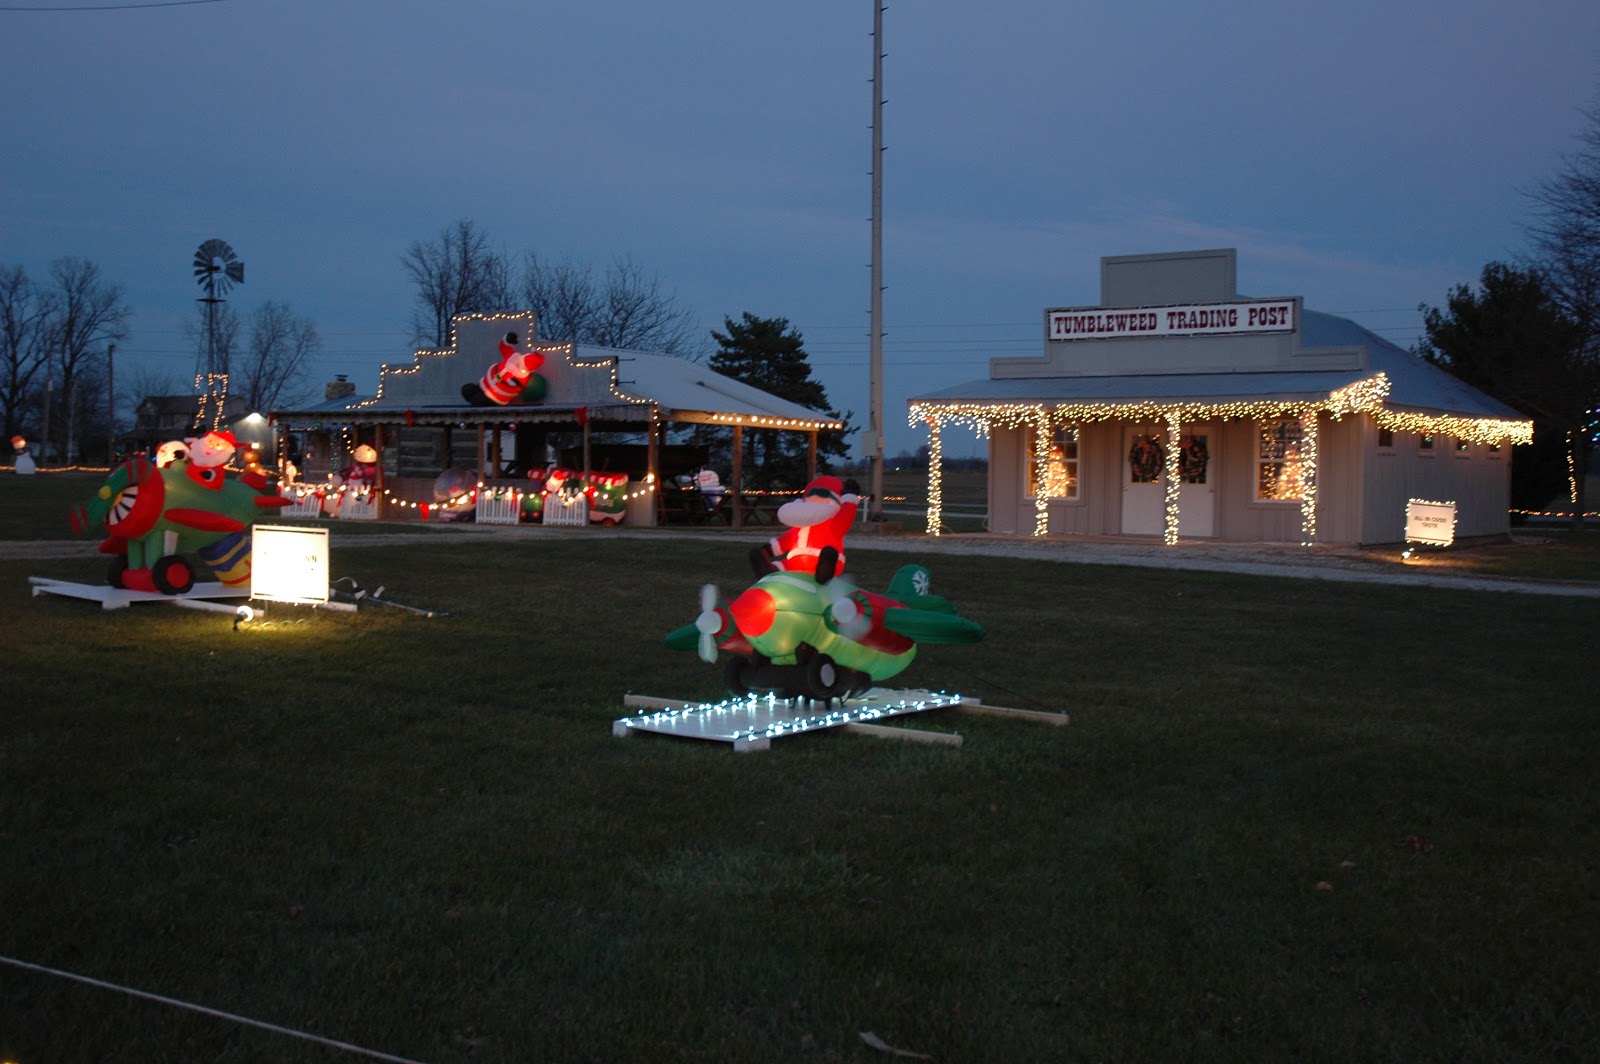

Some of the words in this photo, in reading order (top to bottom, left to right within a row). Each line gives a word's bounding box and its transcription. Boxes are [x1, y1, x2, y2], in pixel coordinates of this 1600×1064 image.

[1055, 313, 1157, 334] TUMBLEWEED
[1167, 308, 1238, 329] TRADING
[1248, 306, 1288, 326] POST
